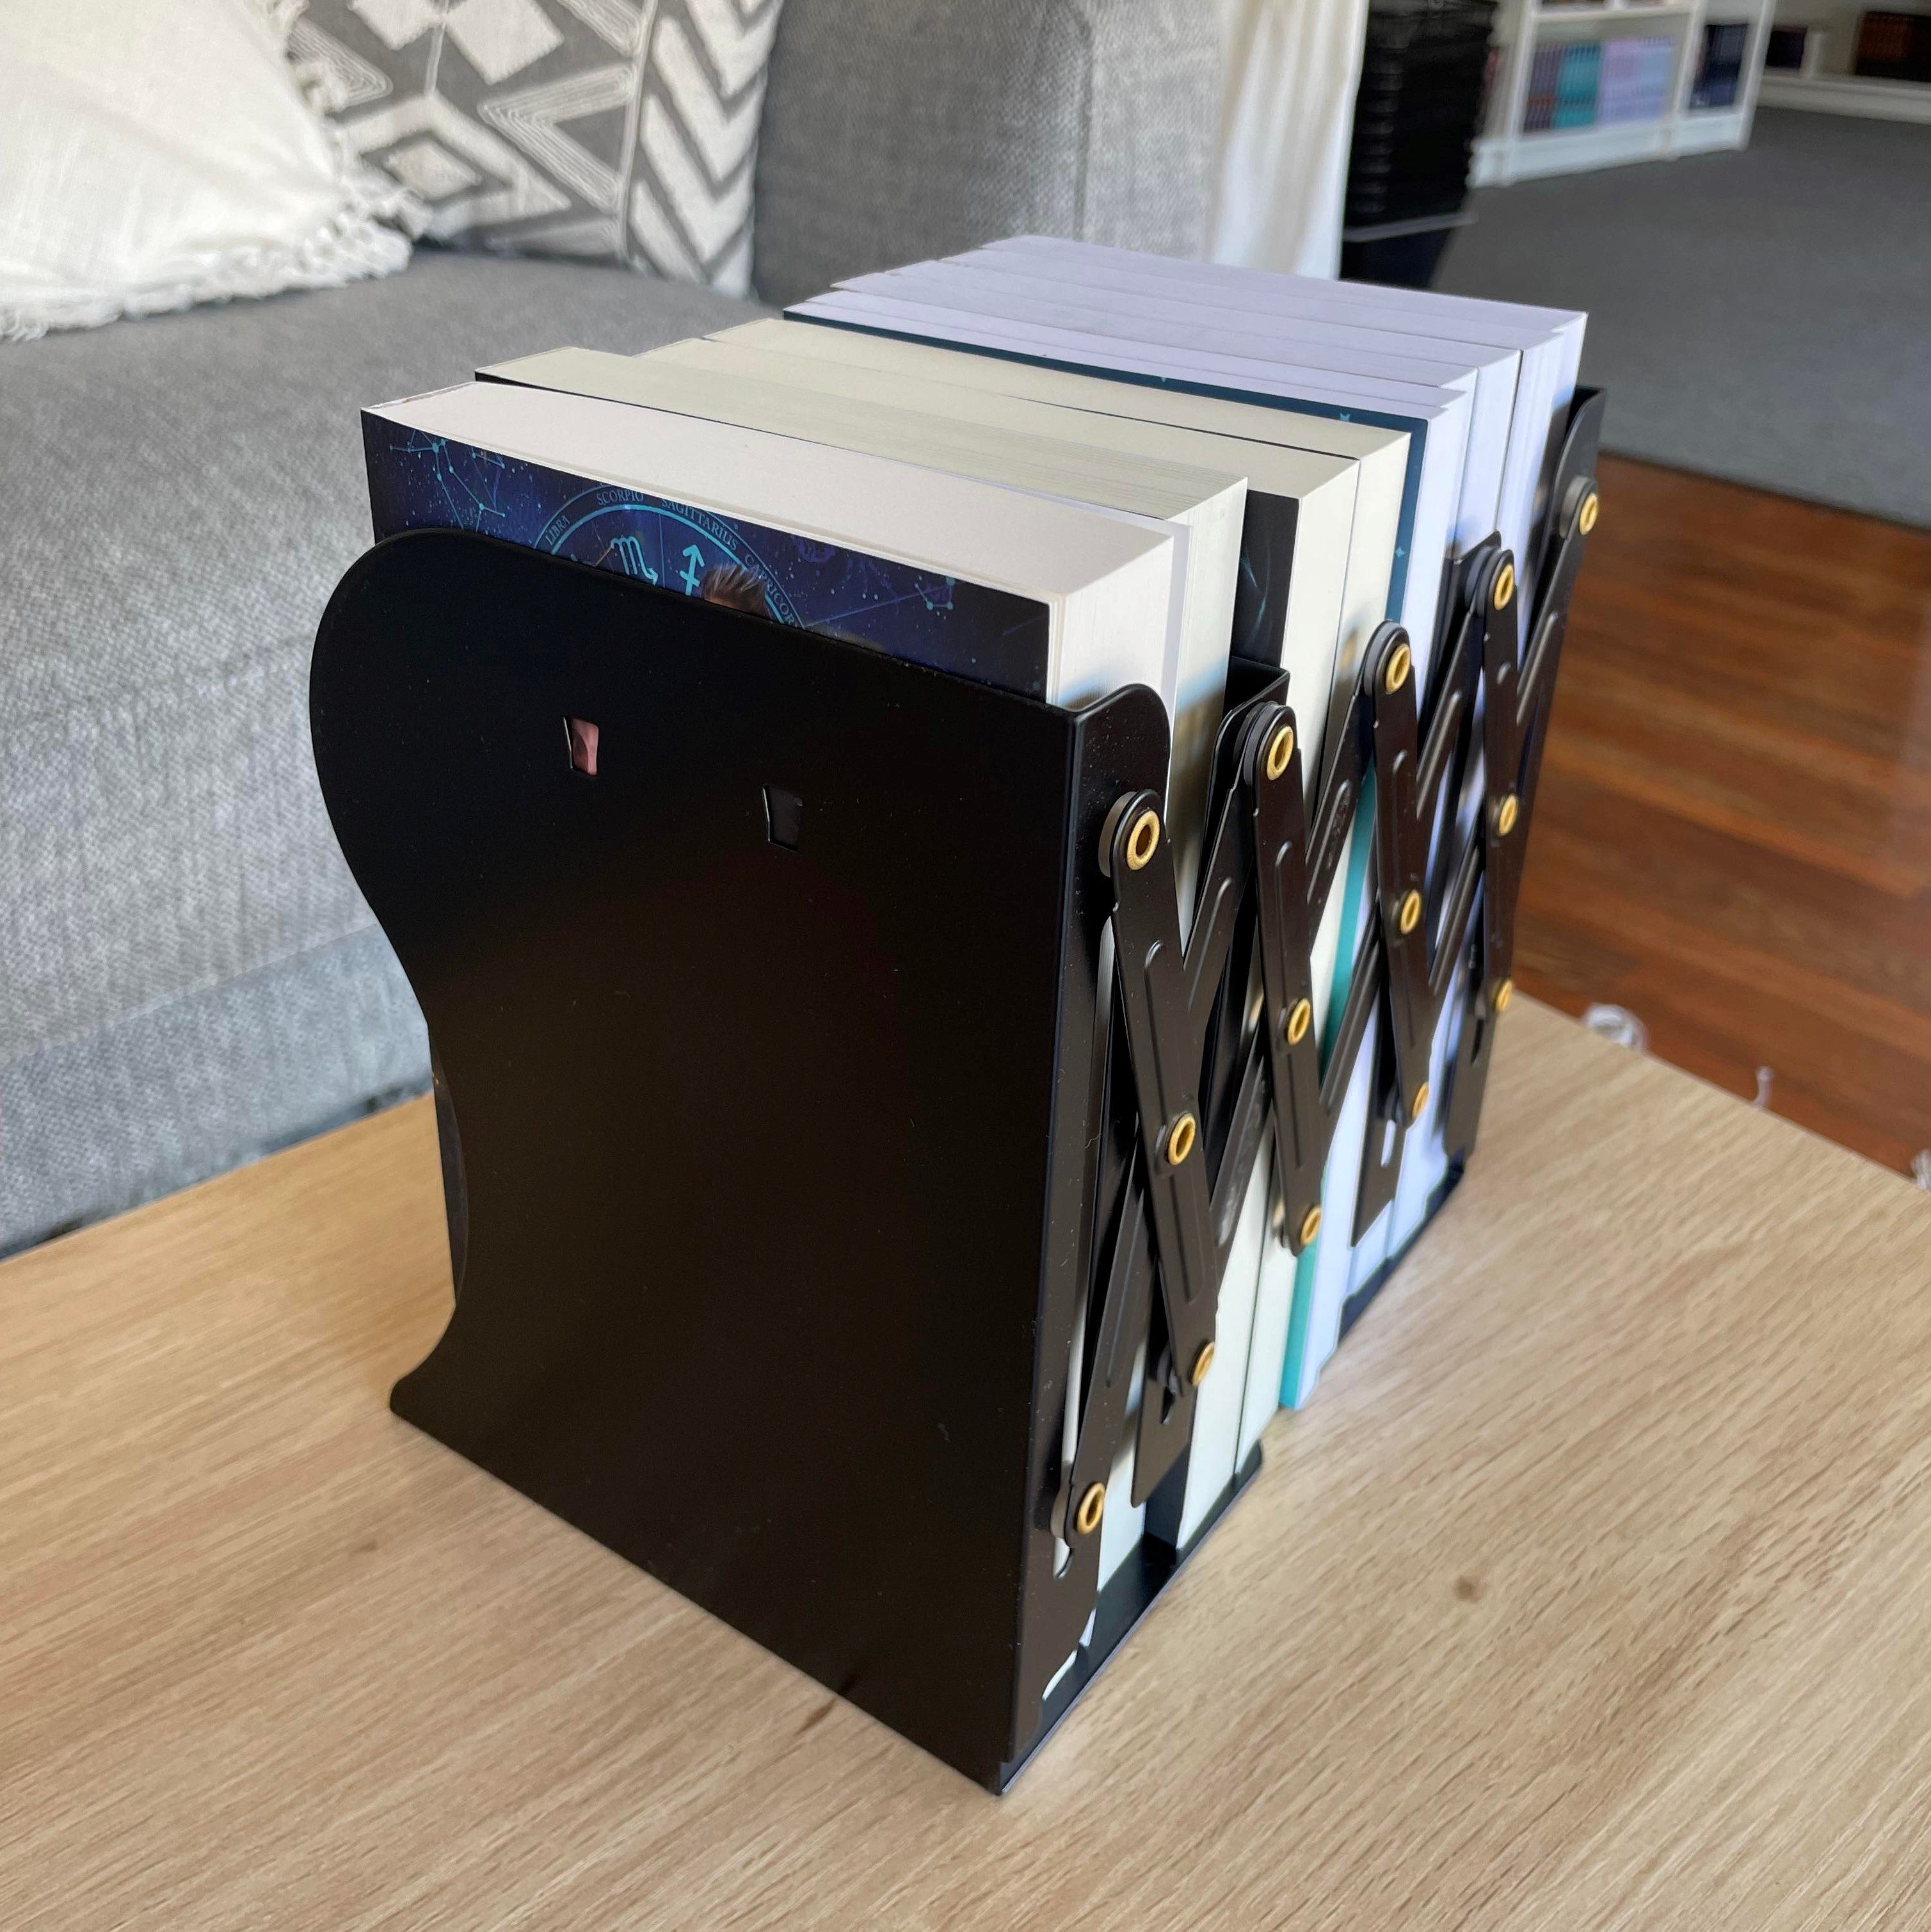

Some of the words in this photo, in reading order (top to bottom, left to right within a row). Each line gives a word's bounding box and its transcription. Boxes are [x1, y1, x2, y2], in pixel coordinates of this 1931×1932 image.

[596, 489, 644, 506] SCORPIO
[545, 515, 571, 545] LIBRA
[661, 499, 738, 550] SAGITTARIUS
[745, 554, 797, 627] CAPRICOR
